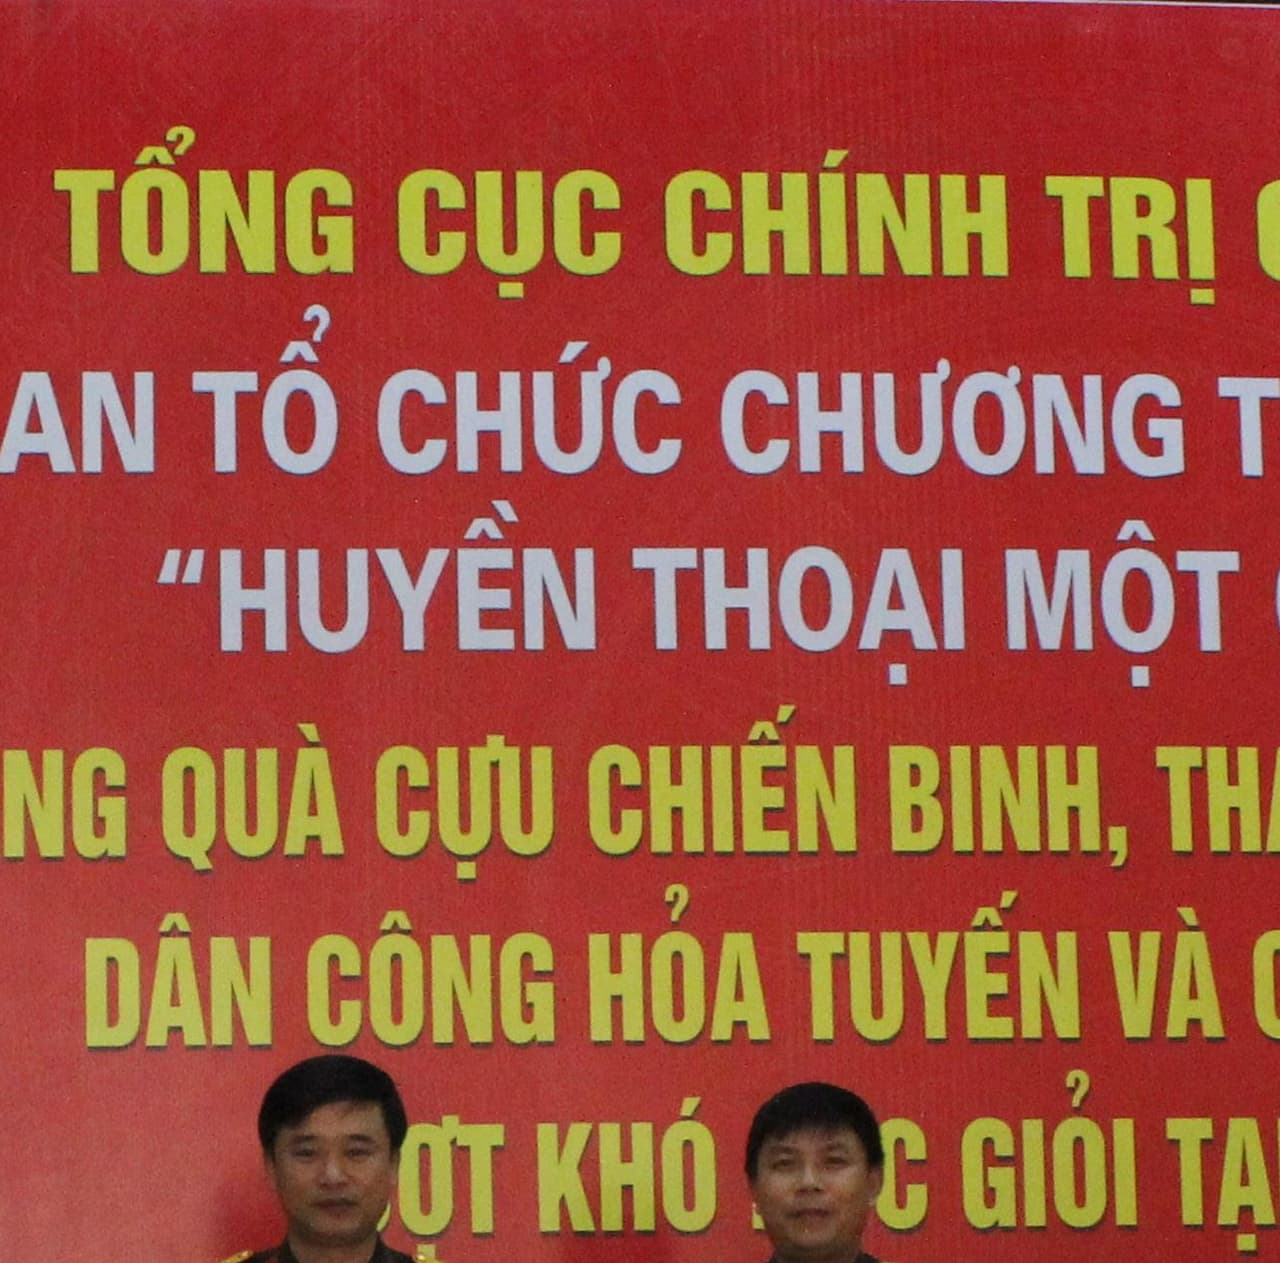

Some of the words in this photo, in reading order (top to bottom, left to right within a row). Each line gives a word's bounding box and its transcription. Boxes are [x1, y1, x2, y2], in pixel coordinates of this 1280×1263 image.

[54, 126, 354, 275] TỔNG
[398, 169, 621, 298] CỤC
[665, 150, 1008, 276] CHÍNH
[1045, 176, 1215, 304] TRỊ
[192, 304, 338, 474] TỔ
[378, 341, 682, 474] CHỨC
[721, 359, 1184, 477] CHƯƠNG
[158, 500, 596, 653] “HUYỀN
[632, 546, 965, 685] THOẠI
[1005, 519, 1240, 687] MỘT
[162, 723, 344, 870] QUÀ
[375, 735, 554, 879] CỰU
[588, 705, 857, 854] CHIẾN
[889, 745, 1128, 866] BINH,
[85, 912, 273, 1048] DÂN
[307, 910, 555, 1046] CÔNG
[589, 884, 770, 1042] HỎA
[797, 891, 1080, 1041] TUYẾN
[1109, 907, 1224, 1038] VÀ
[377, 1115, 505, 1257] ỢT
[537, 1097, 717, 1232] KHÓ
[961, 1070, 1137, 1228] GIỎI
